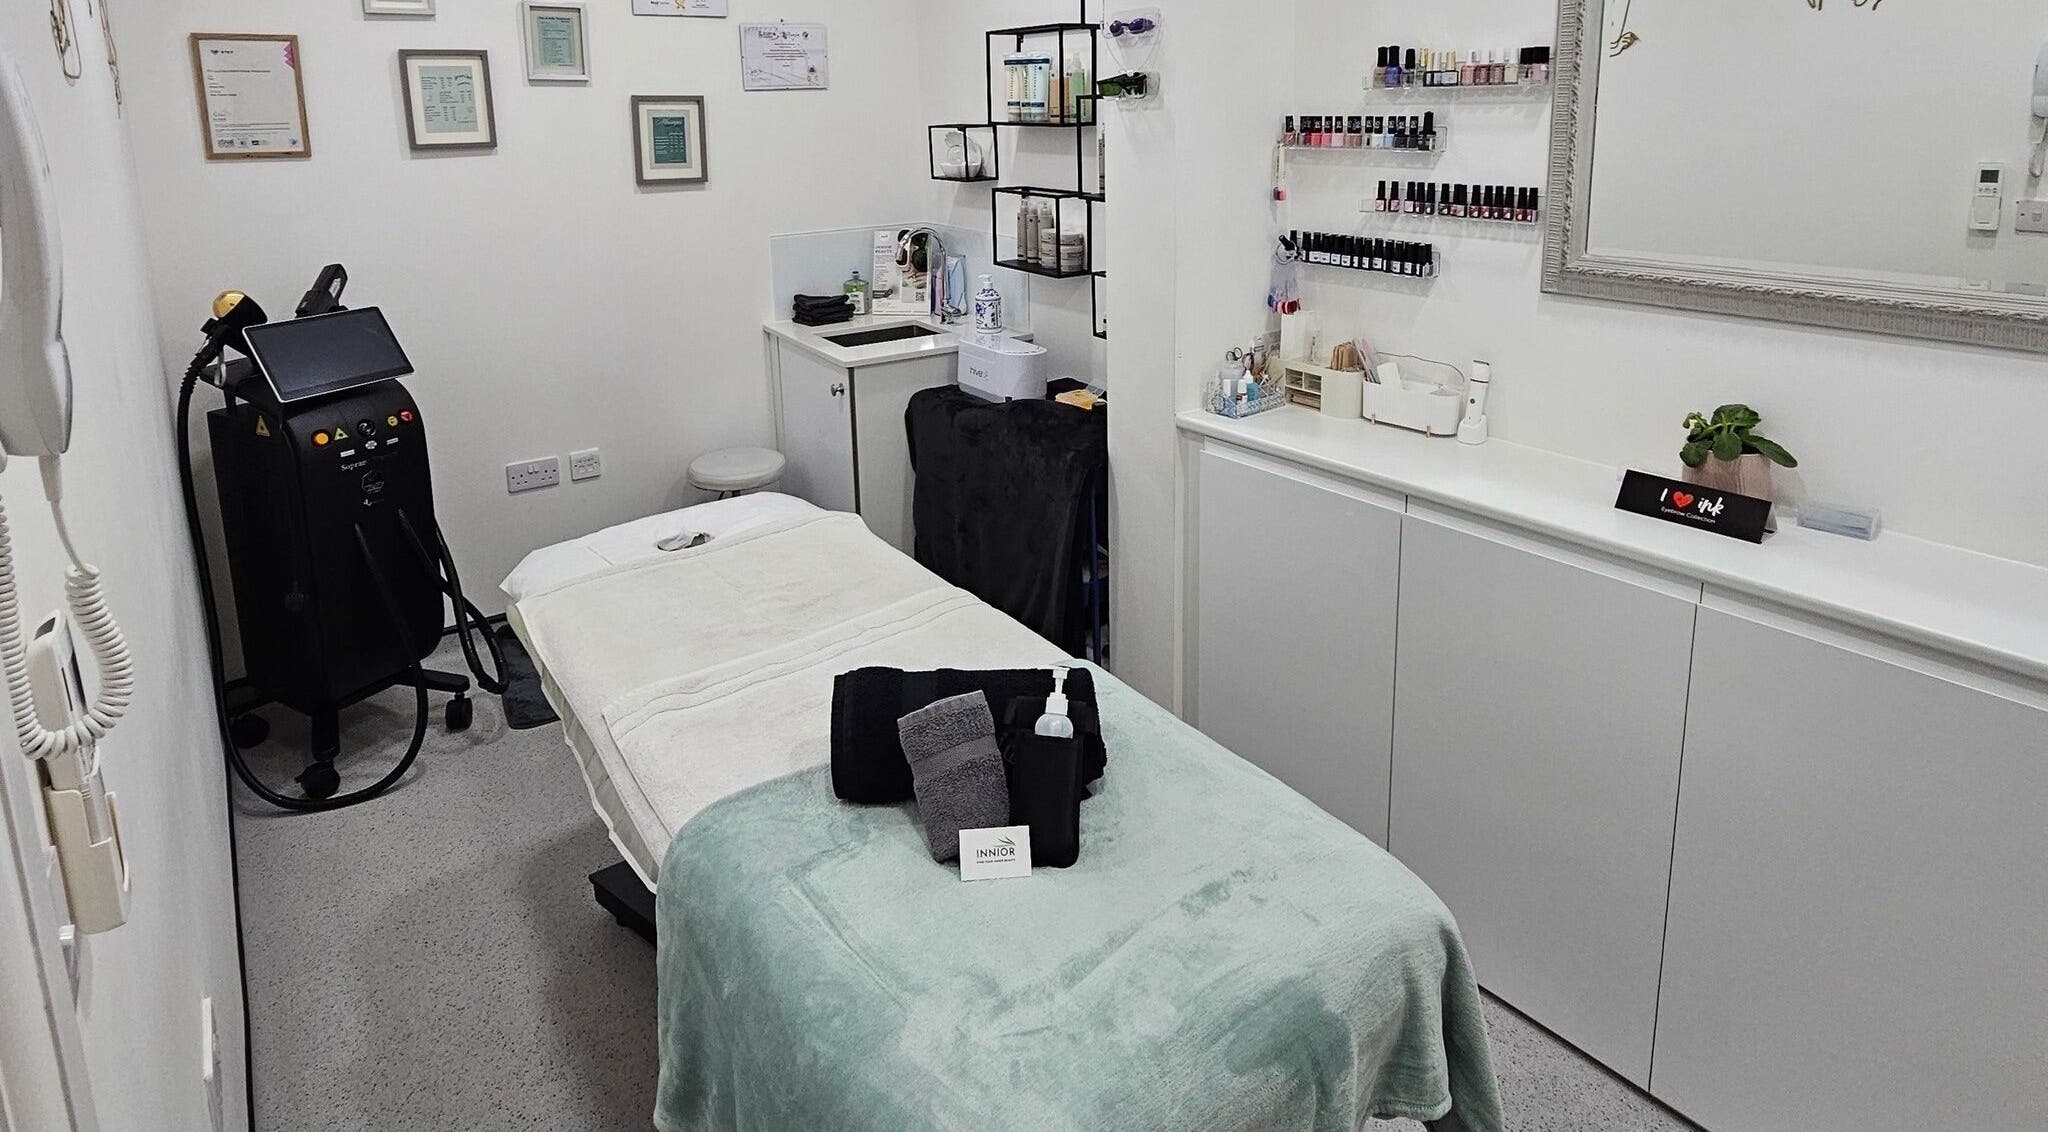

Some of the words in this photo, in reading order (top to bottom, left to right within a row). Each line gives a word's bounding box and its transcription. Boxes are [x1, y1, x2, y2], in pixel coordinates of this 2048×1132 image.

[1660, 488, 1668, 502] I
[1697, 496, 1724, 517] ink
[1661, 506, 1685, 516] Eyebrow
[1686, 512, 1716, 524] Collection
[976, 847, 1015, 858] INNIOR
